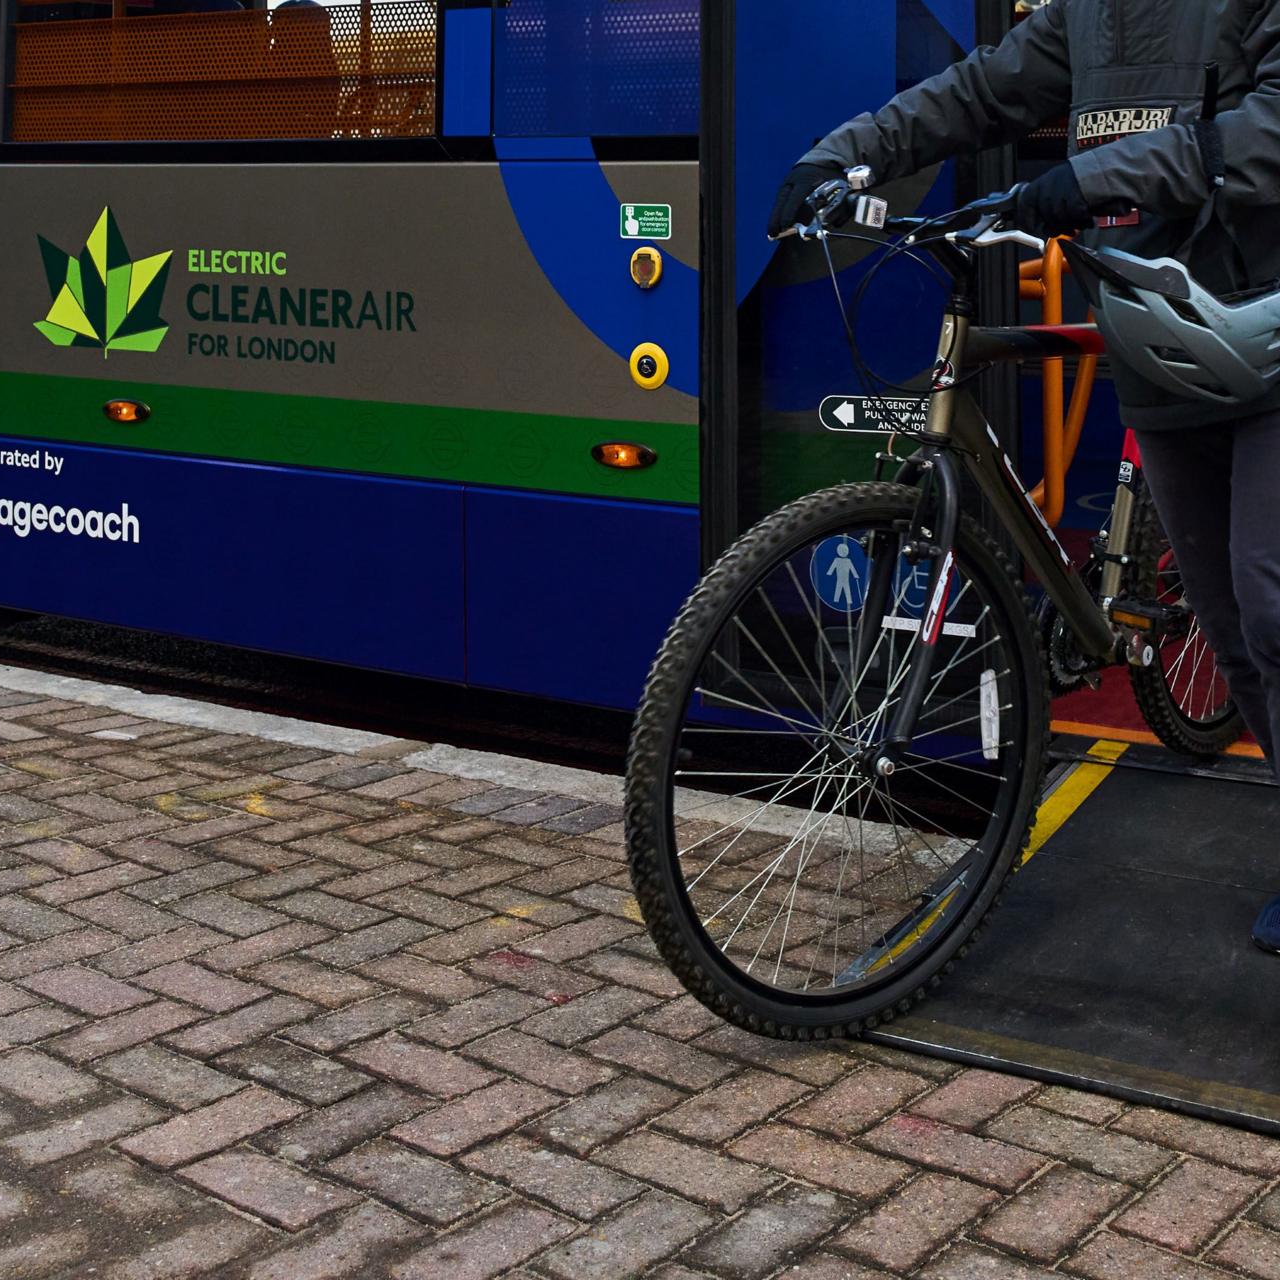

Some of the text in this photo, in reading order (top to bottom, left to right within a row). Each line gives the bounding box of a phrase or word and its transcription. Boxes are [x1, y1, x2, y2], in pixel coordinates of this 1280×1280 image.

[188, 248, 287, 276] ELECTRIC
[186, 283, 418, 332] CLEANERAIR
[188, 332, 337, 365] FOR LONDON
[43, 451, 64, 476] by
